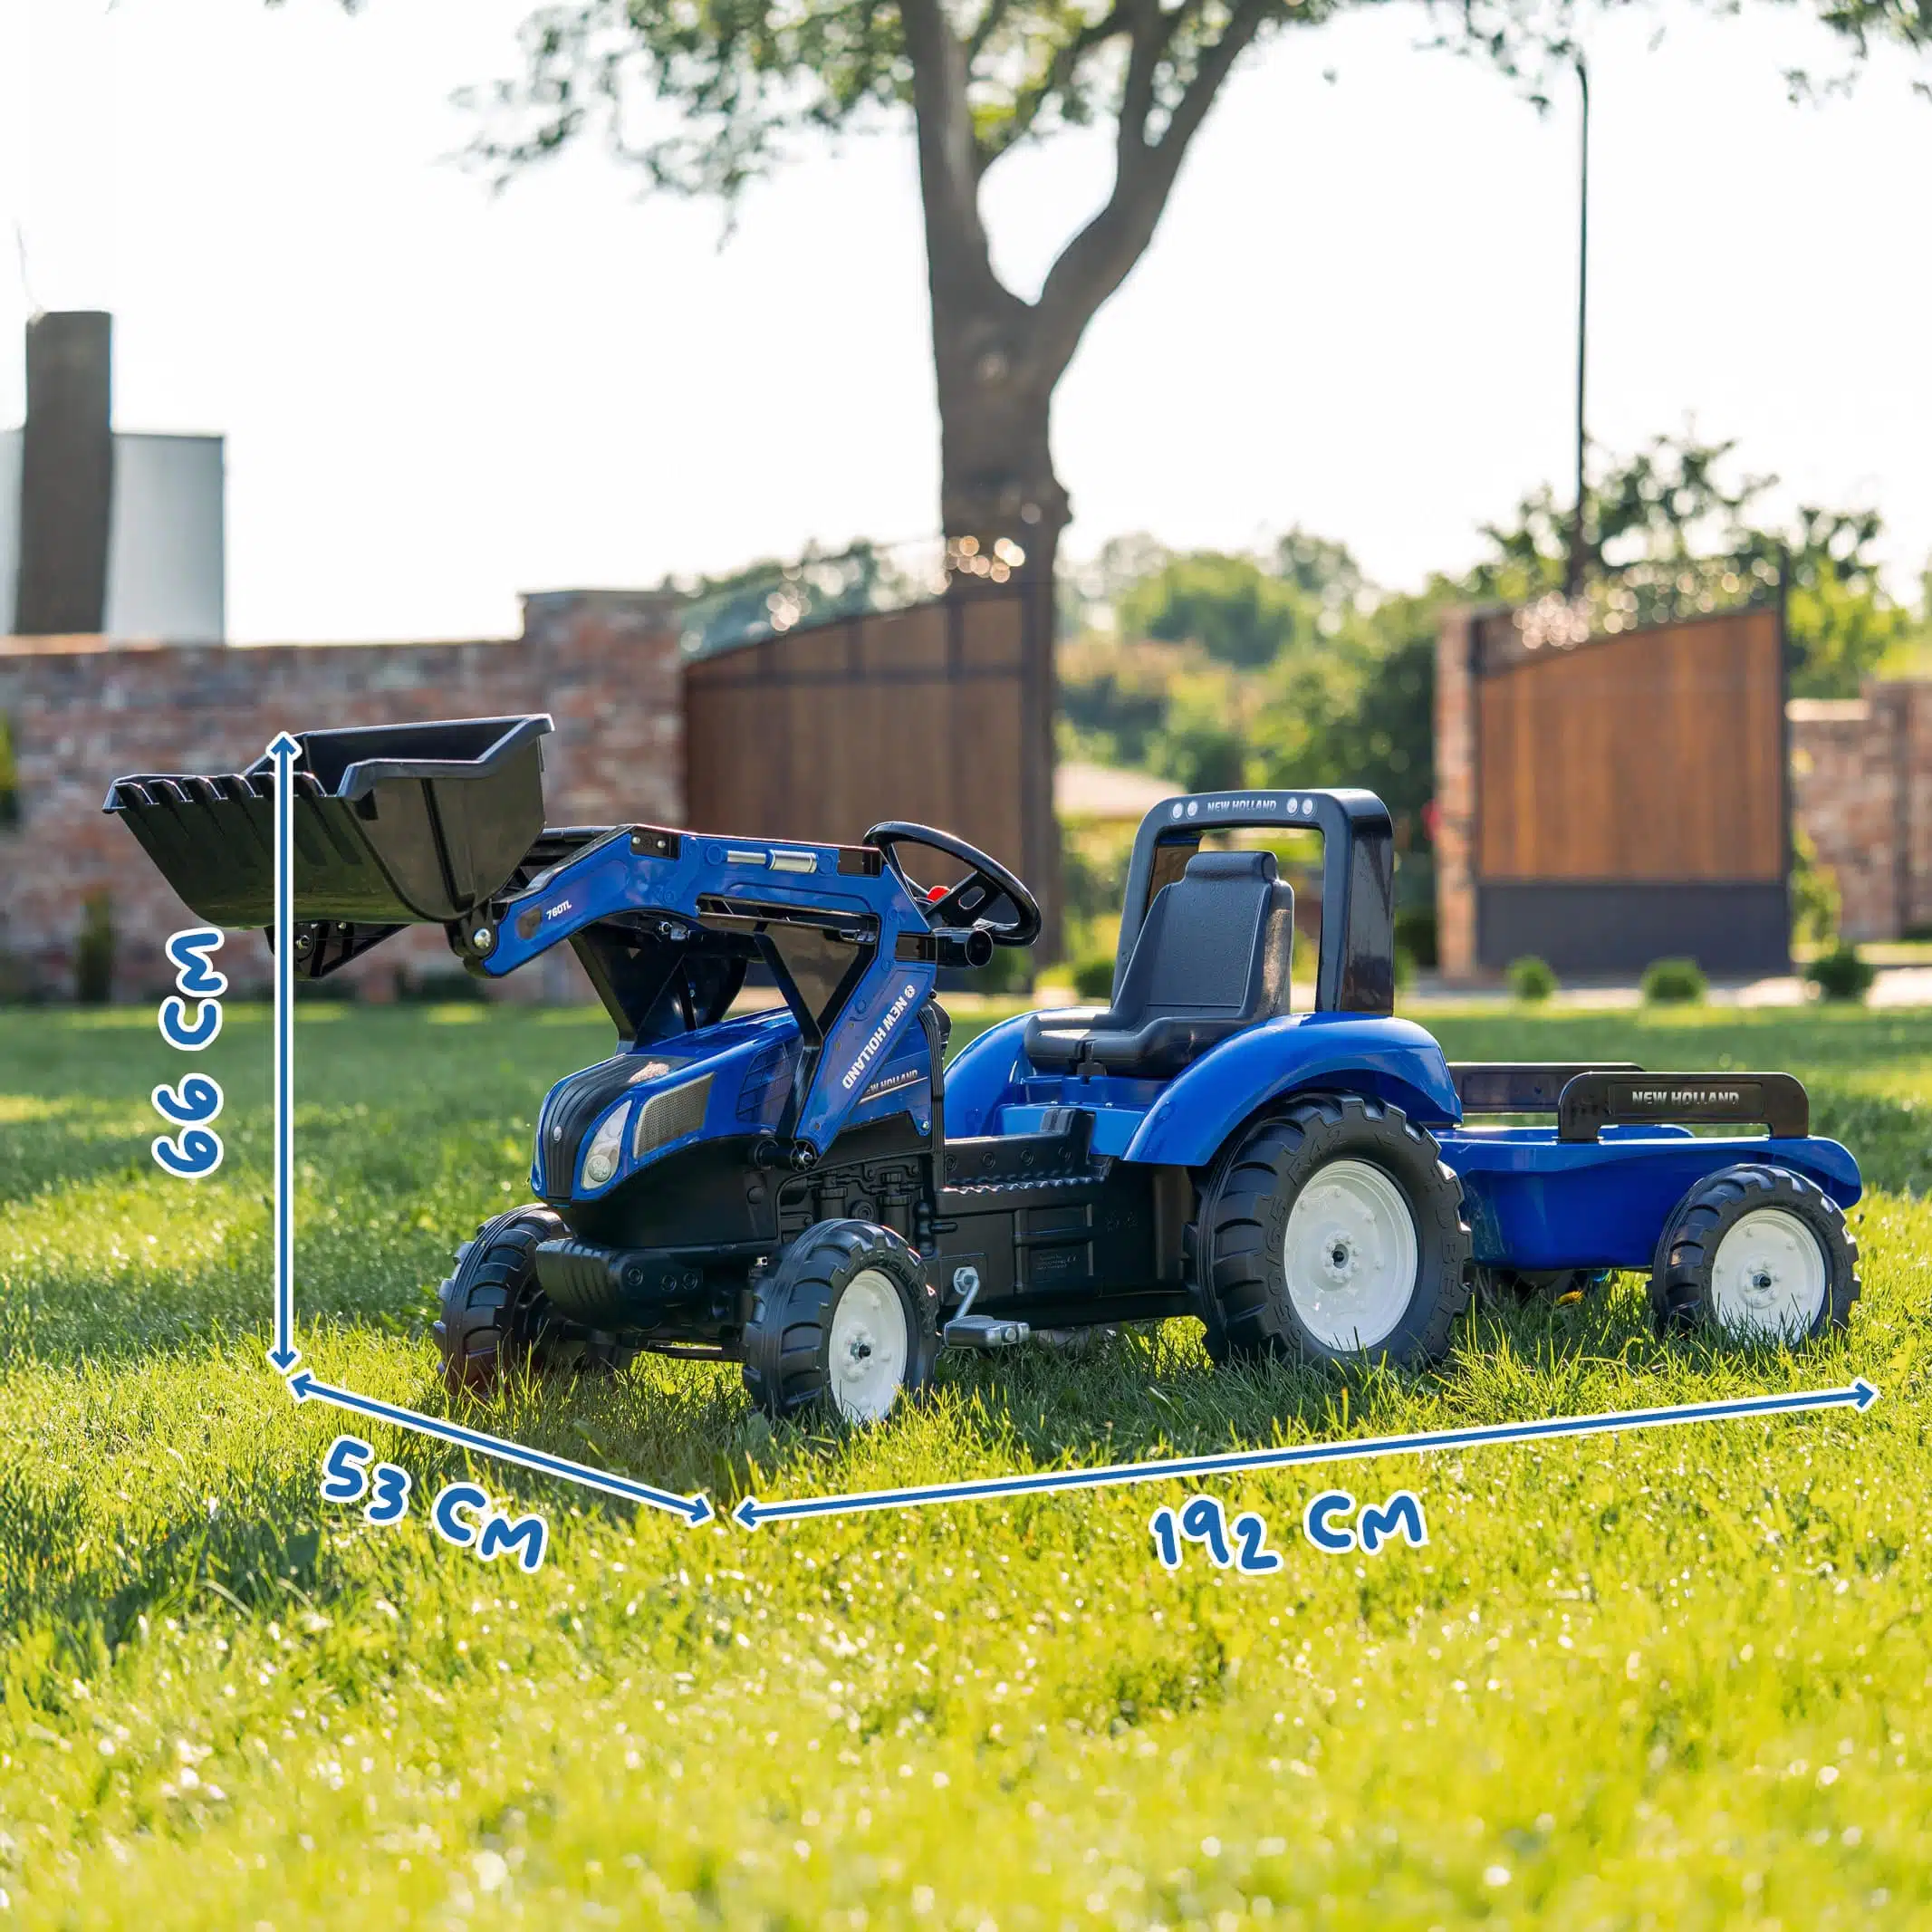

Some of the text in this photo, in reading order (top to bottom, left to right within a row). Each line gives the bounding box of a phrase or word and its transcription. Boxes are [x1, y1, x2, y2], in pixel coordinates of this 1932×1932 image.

[1207, 800, 1277, 812] NEW HOLLAND
[546, 899, 572, 920] 760TL
[842, 996, 908, 1090] NEW HOLLAND
[879, 1069, 918, 1091] HOLLAND
[1632, 1091, 1739, 1105] NEW HOLLAND
